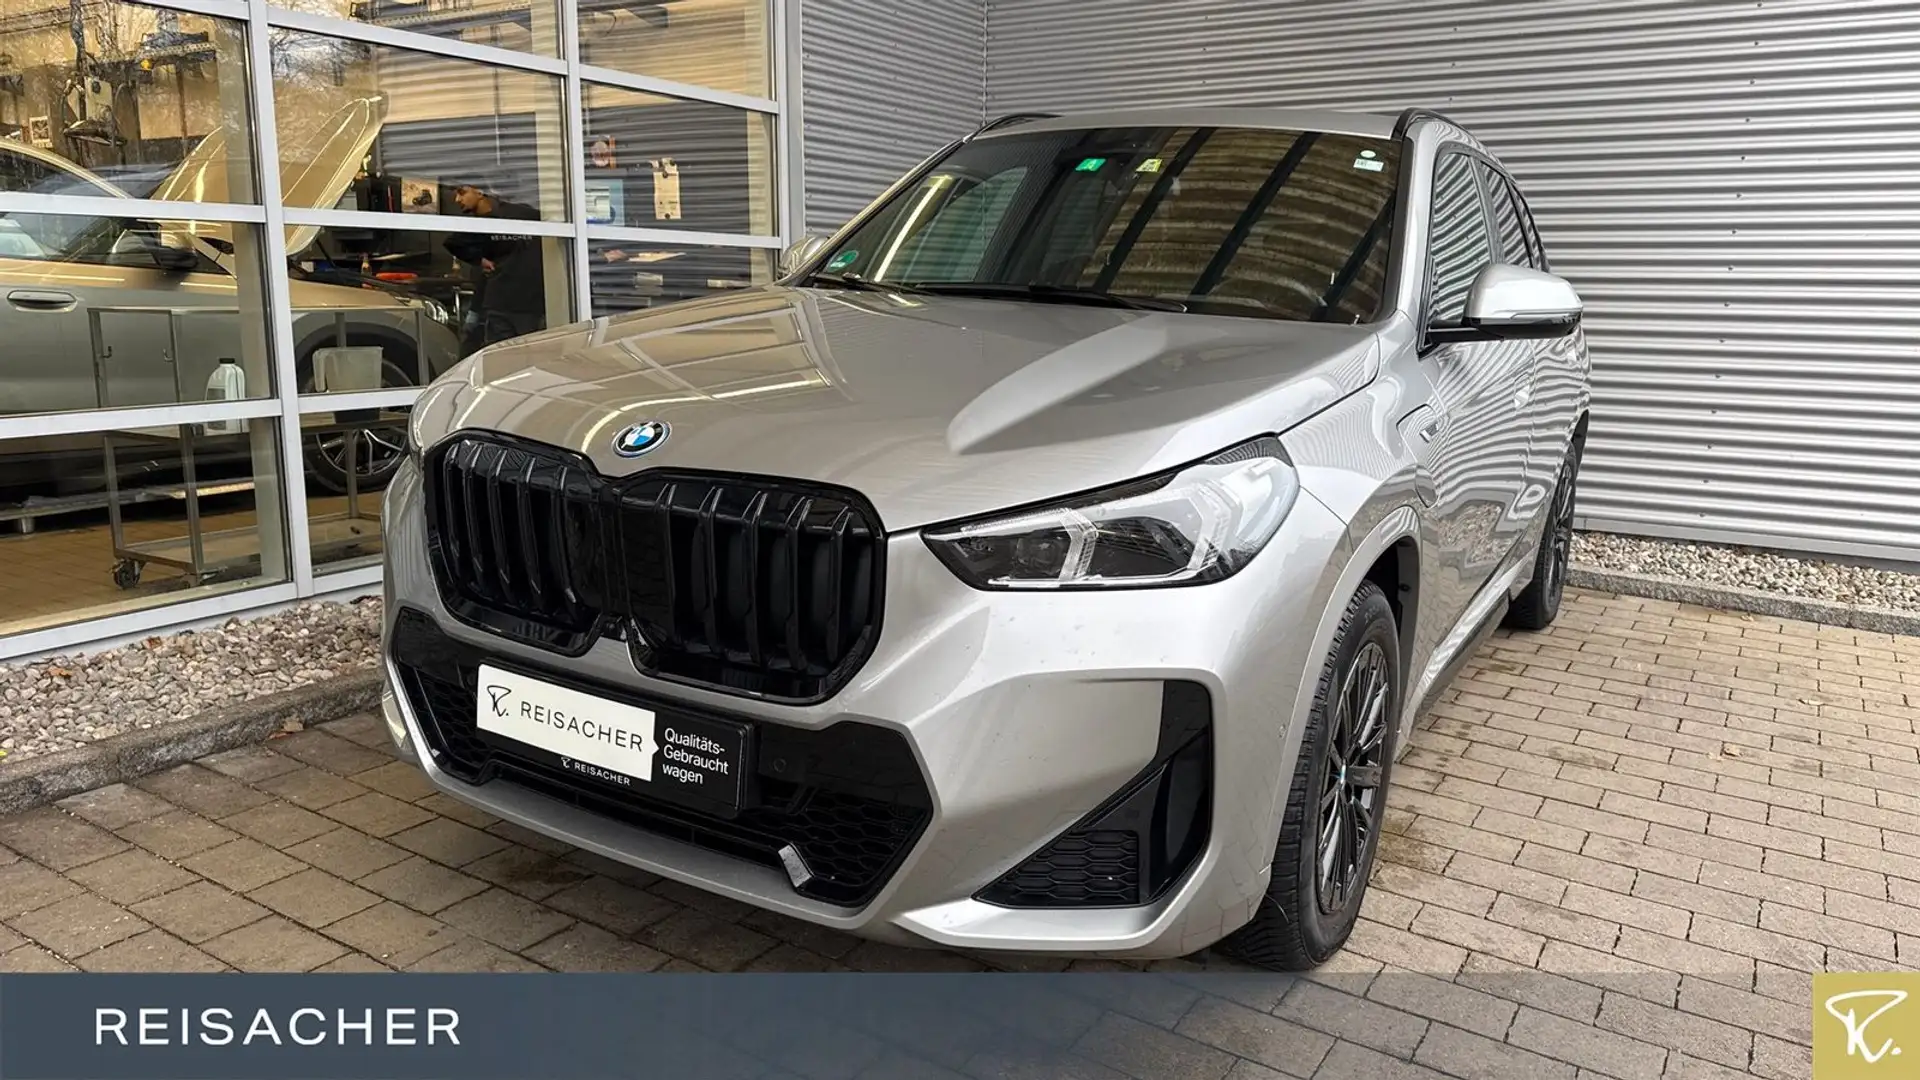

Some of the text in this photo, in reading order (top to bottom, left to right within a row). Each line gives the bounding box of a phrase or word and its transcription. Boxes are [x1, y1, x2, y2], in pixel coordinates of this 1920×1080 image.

[520, 701, 643, 752] REISACHER
[664, 727, 725, 754] Qualitäts-
[663, 744, 729, 775] Gebraucht
[574, 762, 631, 786] REISACHER
[662, 763, 703, 785] wagen
